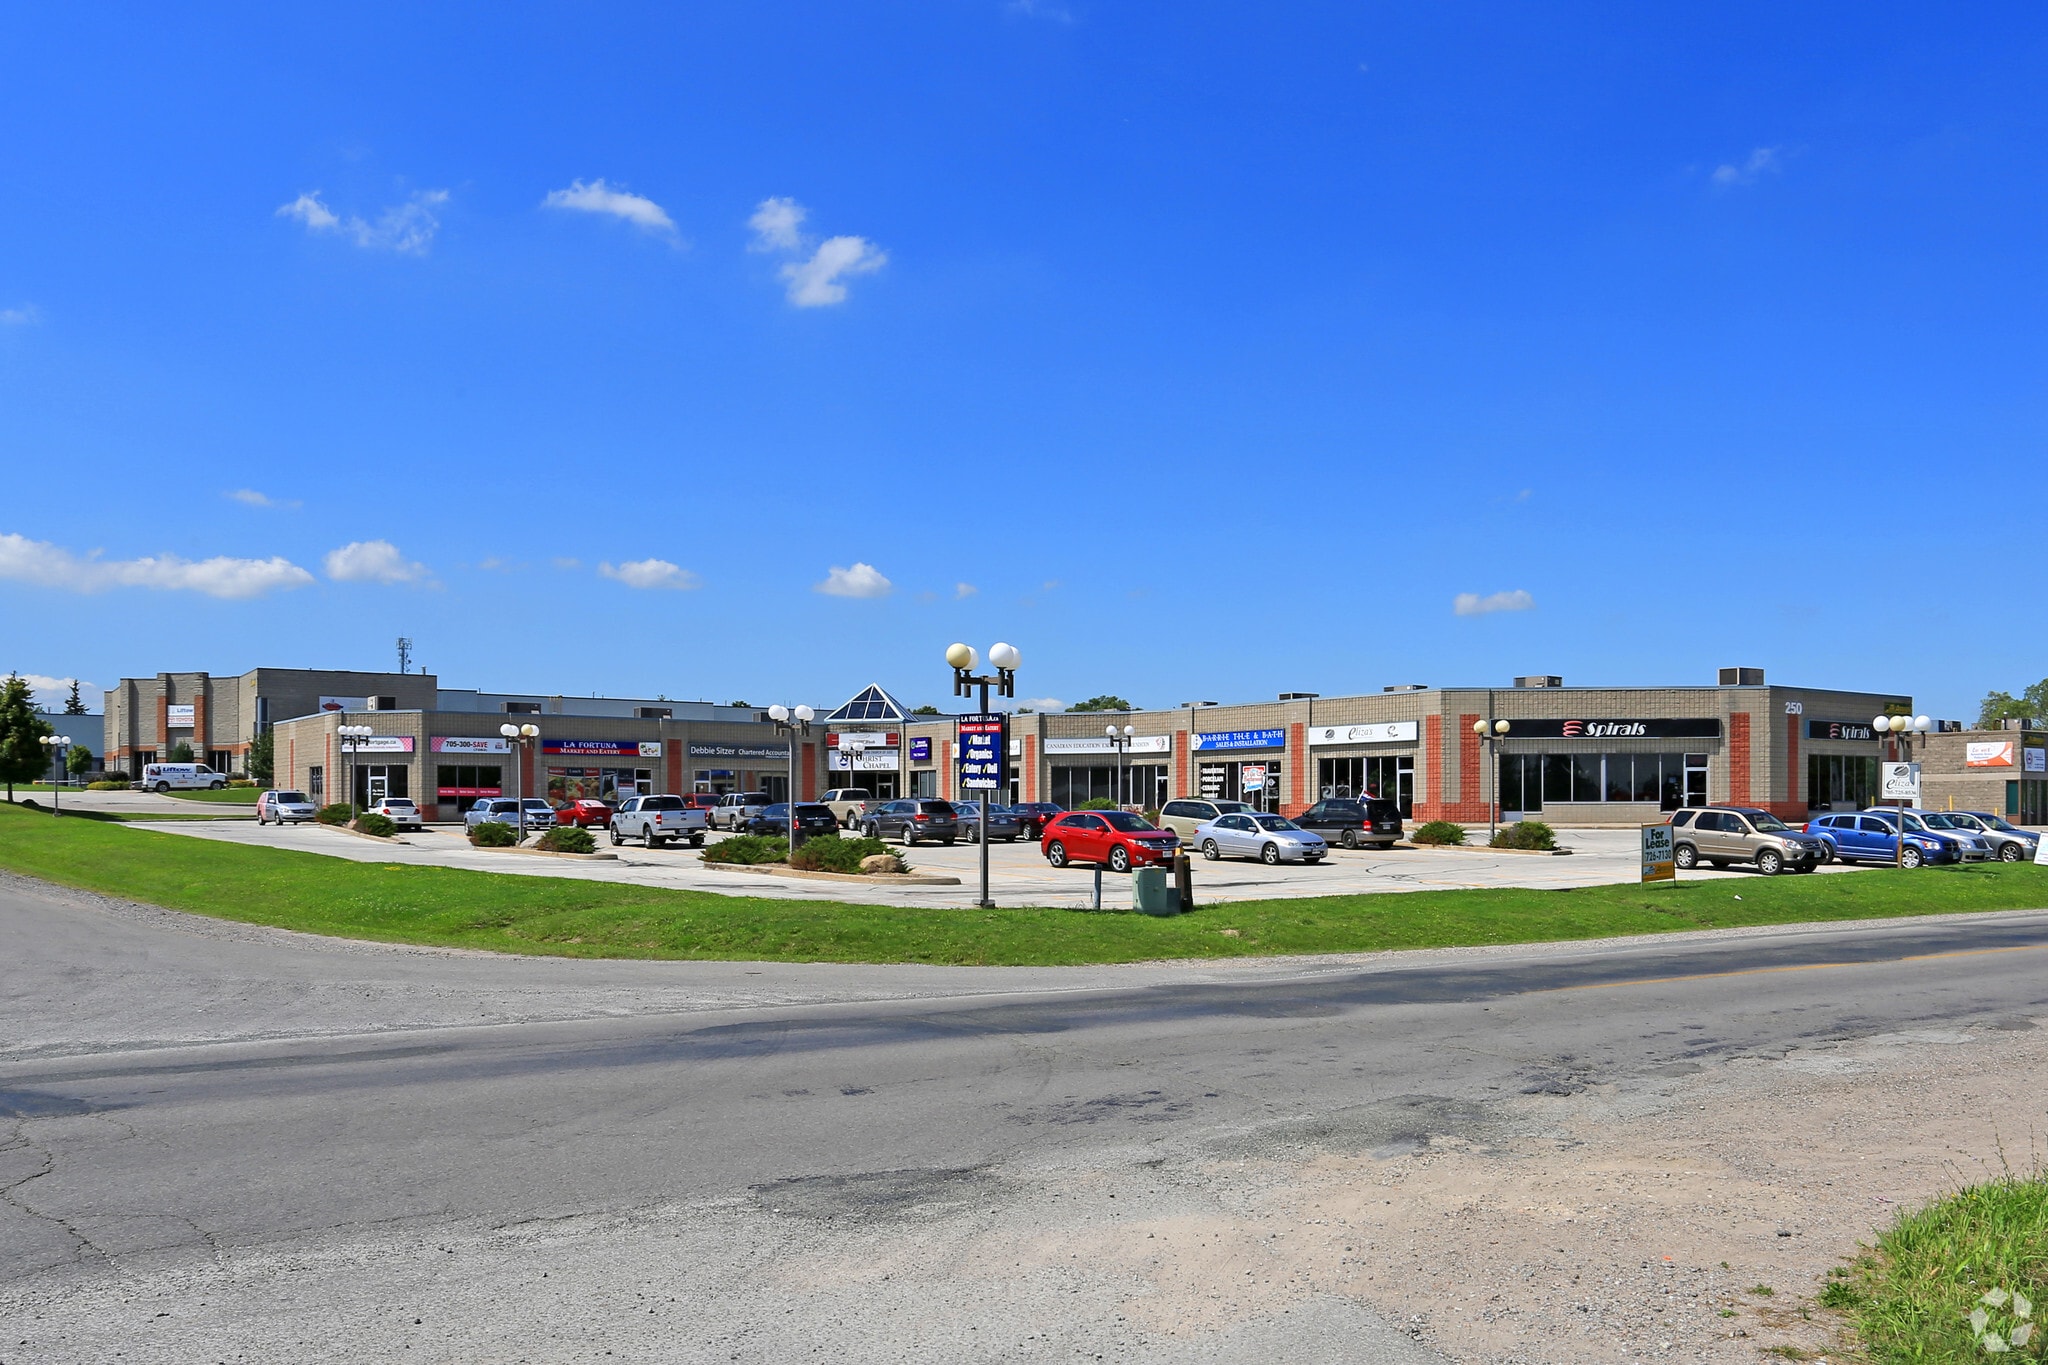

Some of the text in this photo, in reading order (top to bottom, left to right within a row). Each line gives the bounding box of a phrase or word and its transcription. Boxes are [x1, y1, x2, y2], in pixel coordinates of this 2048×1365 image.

[1785, 701, 1803, 714] 250
[1584, 722, 1647, 737] Spirals
[1840, 725, 1870, 740] Spirals
[578, 741, 618, 749] FORTUNA
[1234, 739, 1268, 747] INSTALLATION
[690, 746, 716, 755] Debbie
[716, 746, 735, 755] Sitzer
[738, 748, 765, 756] Chartered
[969, 748, 993, 760] Organics
[862, 761, 891, 769] CHAPEL
[965, 763, 982, 775] Eatery
[965, 777, 997, 789] Sandwiches
[1650, 829, 1665, 840] For
[1645, 838, 1670, 850] Lease
